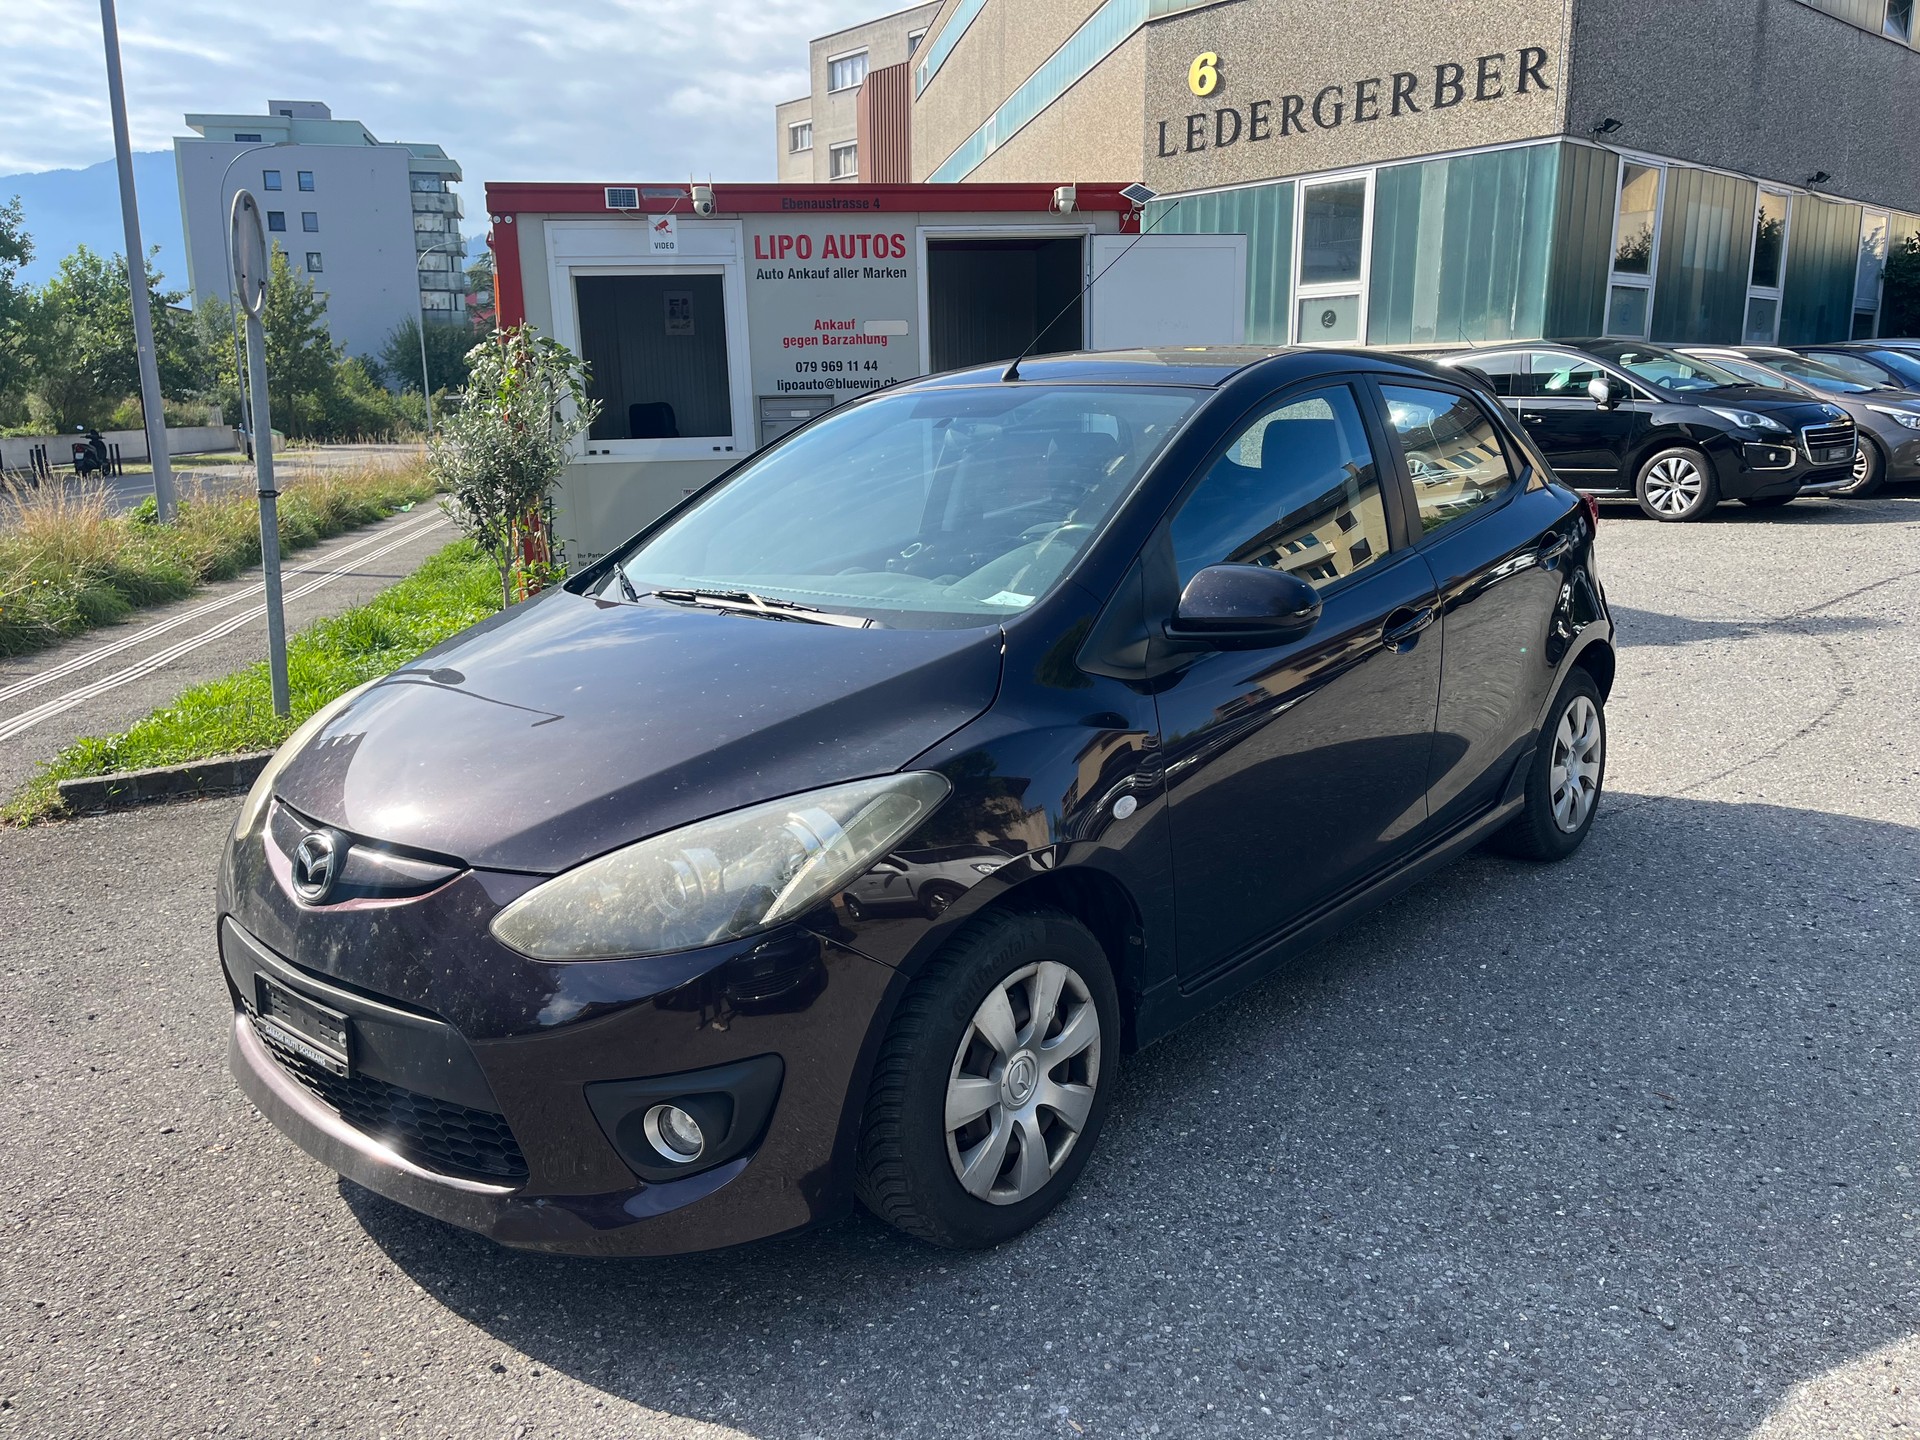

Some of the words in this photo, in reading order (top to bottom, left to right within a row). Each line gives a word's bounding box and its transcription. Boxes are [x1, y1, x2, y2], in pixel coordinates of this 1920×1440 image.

[1187, 51, 1219, 97] 6
[1156, 45, 1553, 158] LEDERGERBER
[782, 198, 869, 209] Ebenaustrasse
[873, 198, 880, 209] 4
[654, 241, 675, 250] VIDEO
[754, 234, 813, 260] LIPO
[822, 233, 906, 259] AUTOS
[756, 268, 784, 280] Auto
[788, 267, 830, 280] Ankauf
[833, 267, 859, 279] aller
[863, 267, 907, 279] Marken
[814, 319, 856, 331] Ankauf
[783, 336, 818, 348] gegen
[822, 334, 888, 347] Barzahlung
[795, 361, 817, 373] 079
[821, 360, 843, 372] 969
[847, 360, 859, 372] 11
[863, 360, 878, 372] 44
